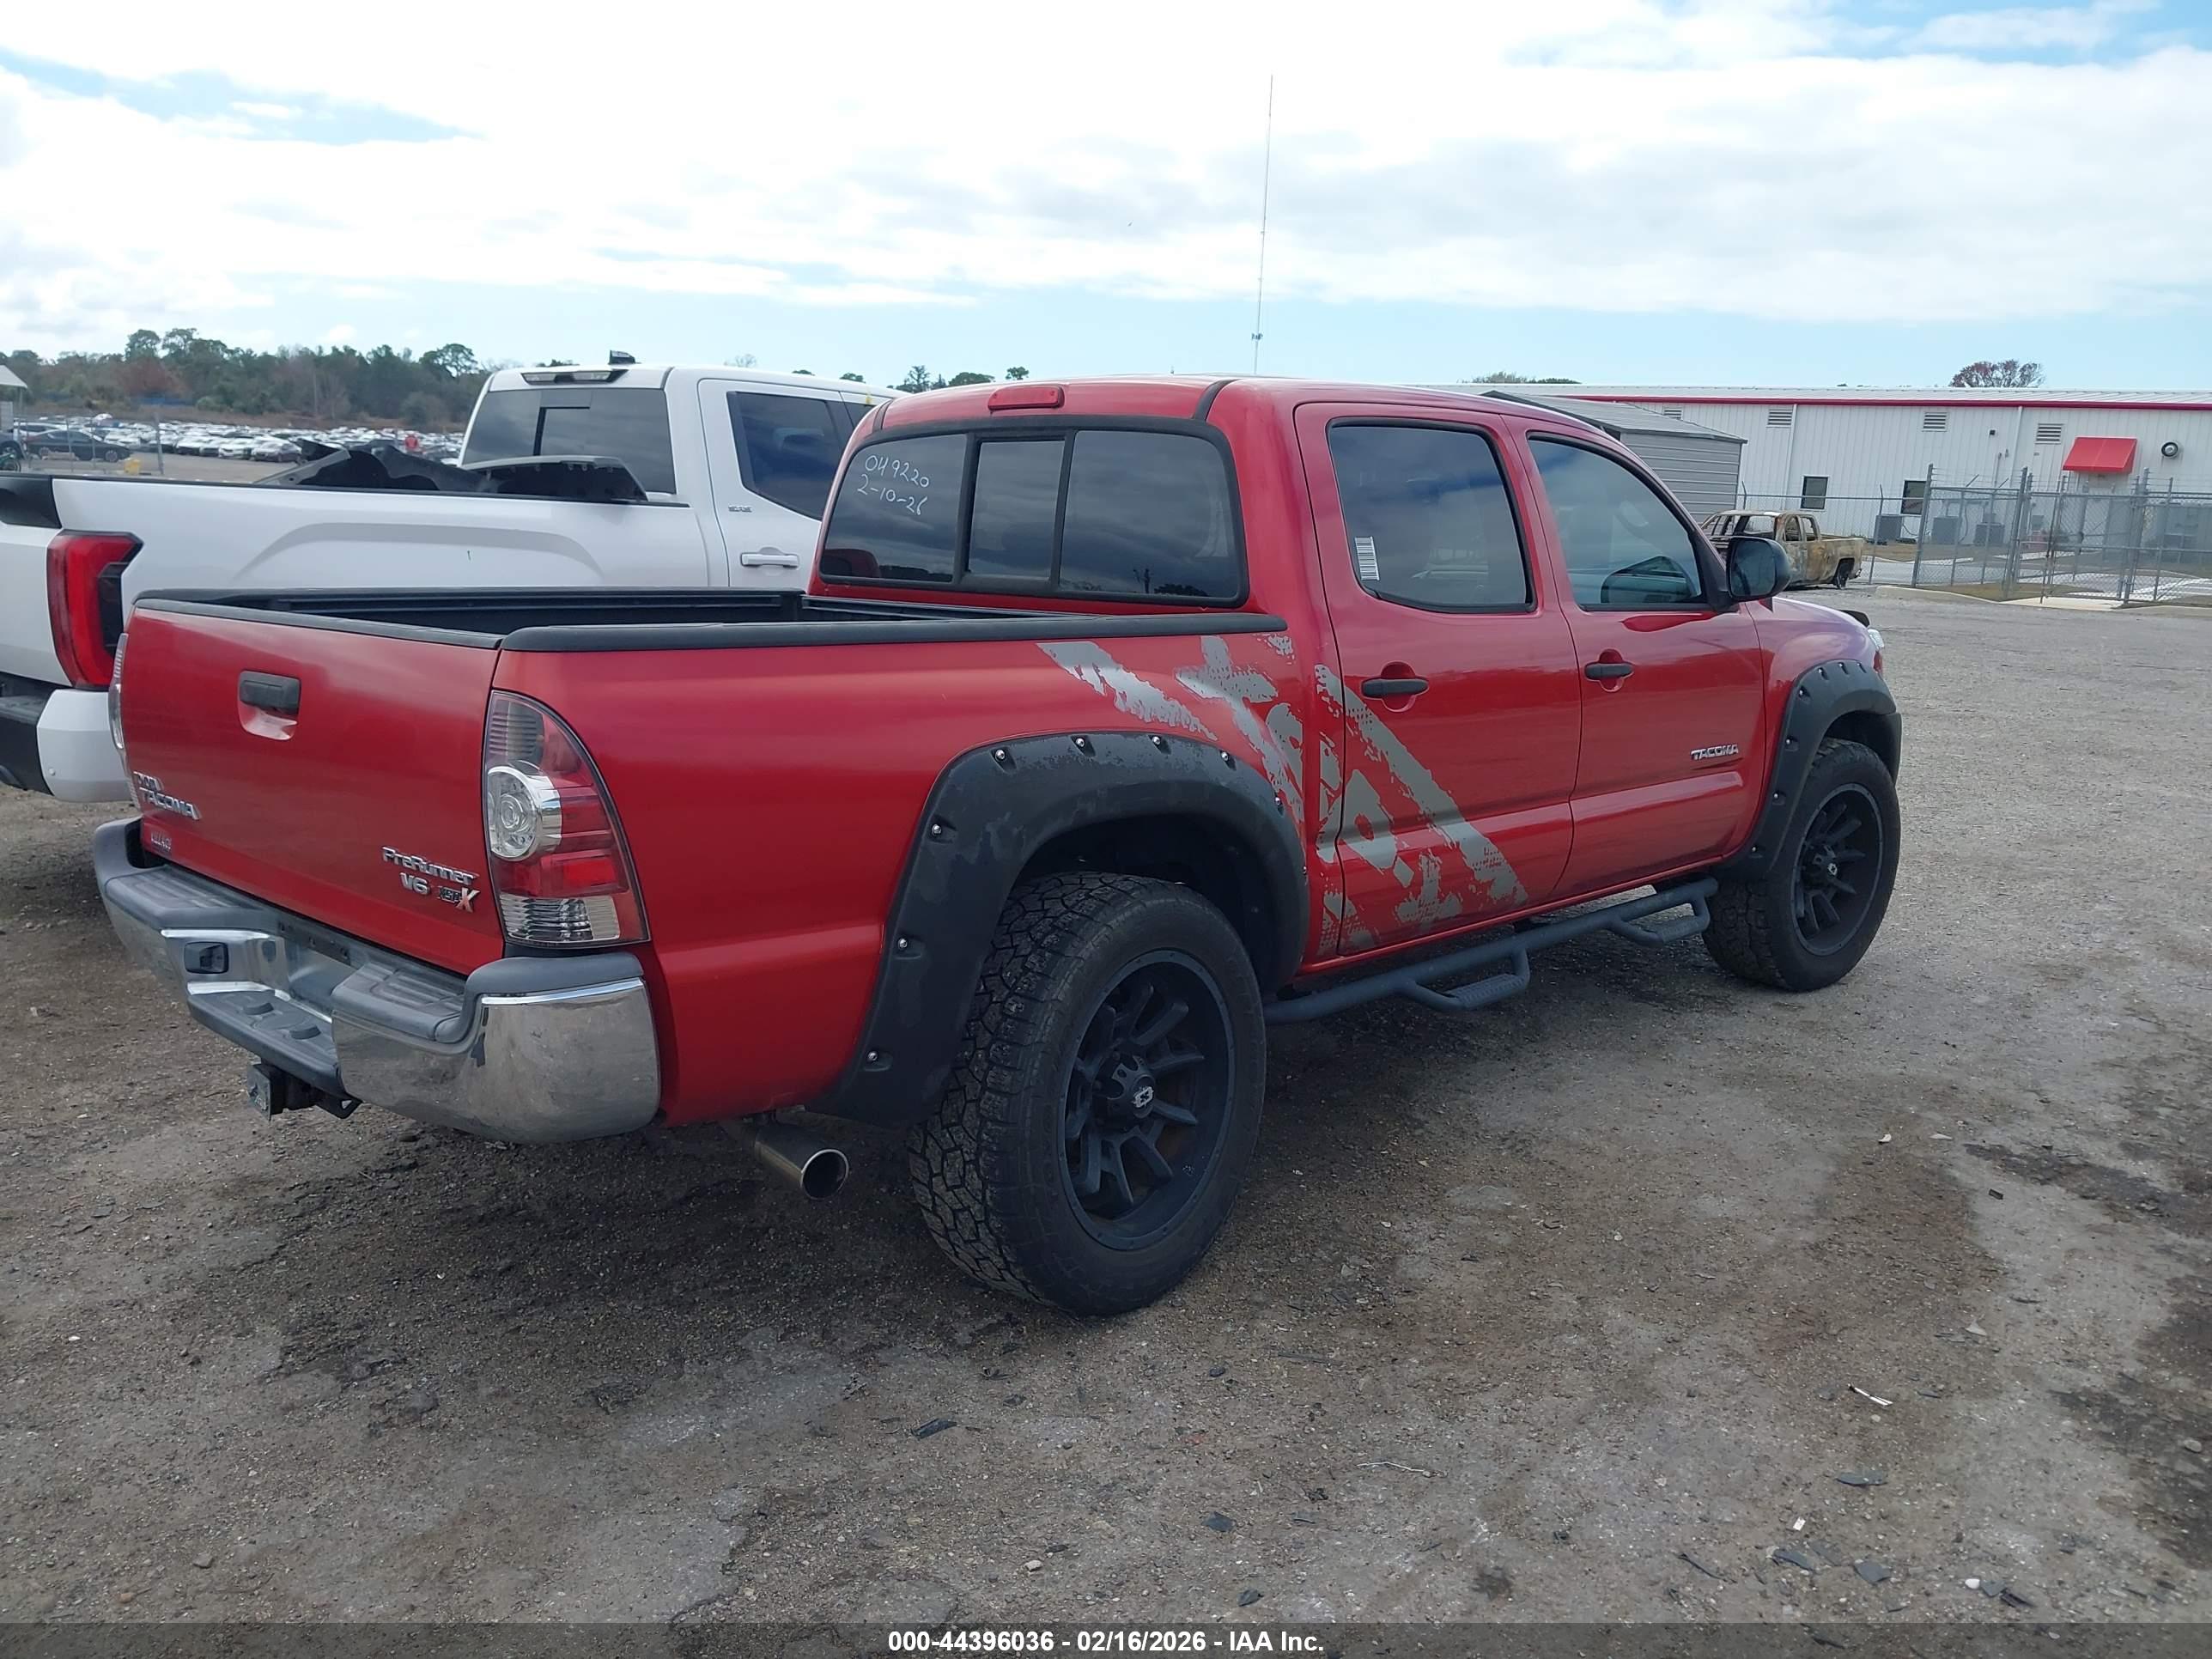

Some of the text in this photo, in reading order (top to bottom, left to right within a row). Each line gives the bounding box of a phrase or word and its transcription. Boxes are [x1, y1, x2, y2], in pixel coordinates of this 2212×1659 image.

[857, 473, 928, 516] 2-10-26
[1690, 744, 1739, 761] TACOMA
[139, 787, 201, 820] TACOMA
[381, 846, 477, 885] PreRunner
[399, 872, 428, 896] V6
